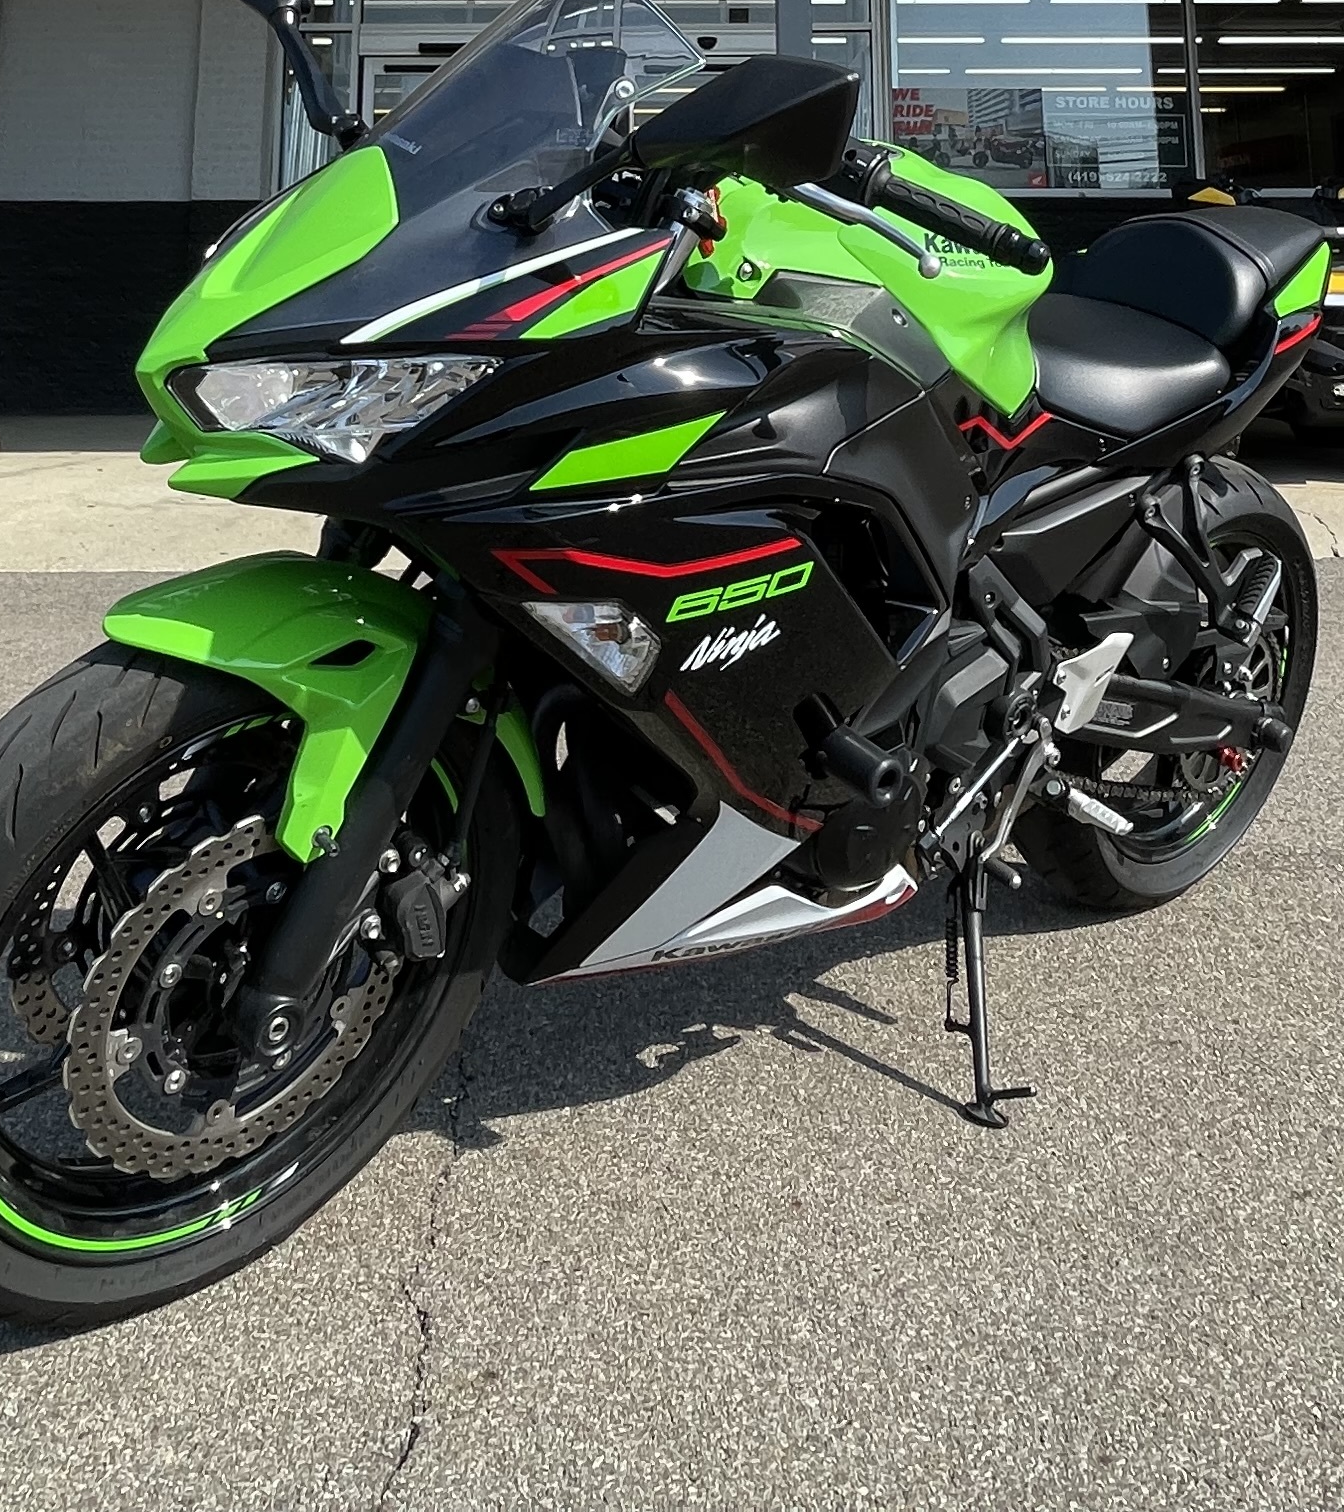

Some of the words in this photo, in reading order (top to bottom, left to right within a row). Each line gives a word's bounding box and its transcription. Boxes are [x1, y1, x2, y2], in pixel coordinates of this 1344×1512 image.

[892, 88, 921, 102] WE
[1056, 96, 1110, 108] STORE
[1115, 96, 1174, 109] HOURS
[893, 104, 934, 118] RIDE
[940, 256, 985, 268] Racing
[665, 561, 814, 623] 650
[679, 613, 781, 672] Ninja
